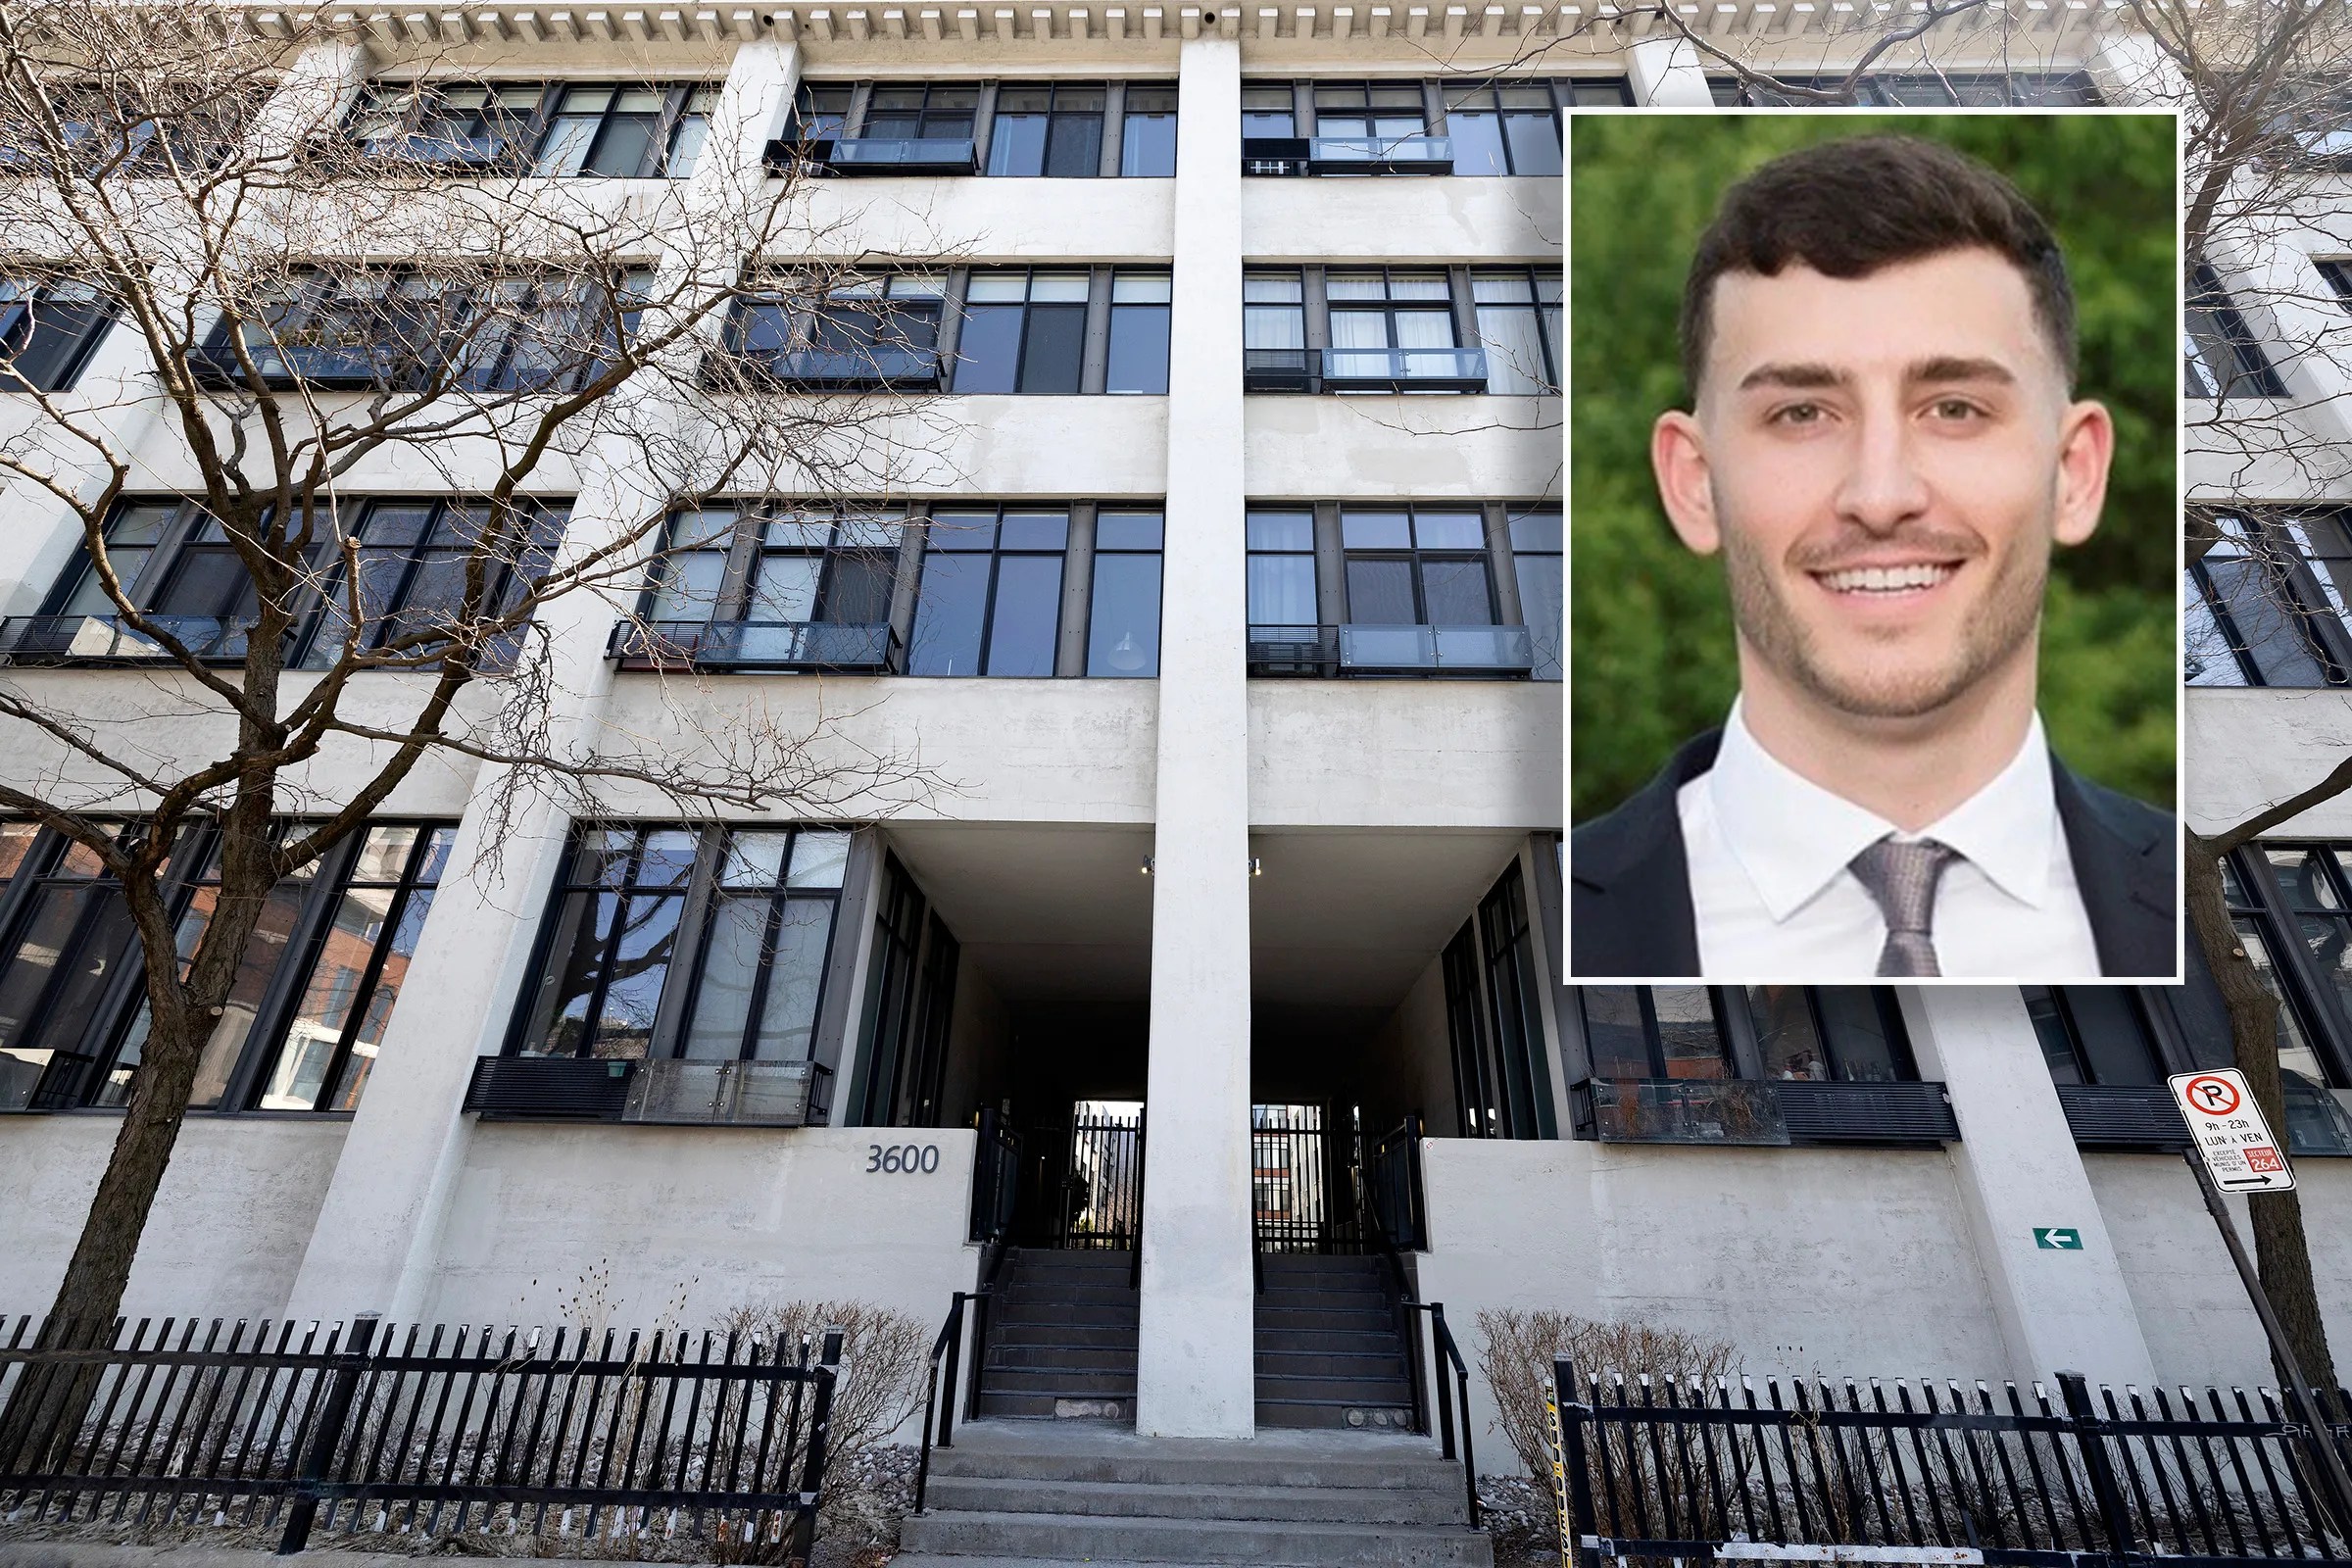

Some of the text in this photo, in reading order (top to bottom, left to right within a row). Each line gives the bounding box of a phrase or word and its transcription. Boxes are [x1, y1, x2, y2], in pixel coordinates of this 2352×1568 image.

[2205, 1121, 2220, 1131] 9h
[2228, 1119, 2250, 1129] 23h
[2204, 1136, 2227, 1146] LUN
[2239, 1132, 2263, 1143] VEN
[866, 1145, 939, 1173] 3600
[2251, 1157, 2279, 1170] 264
